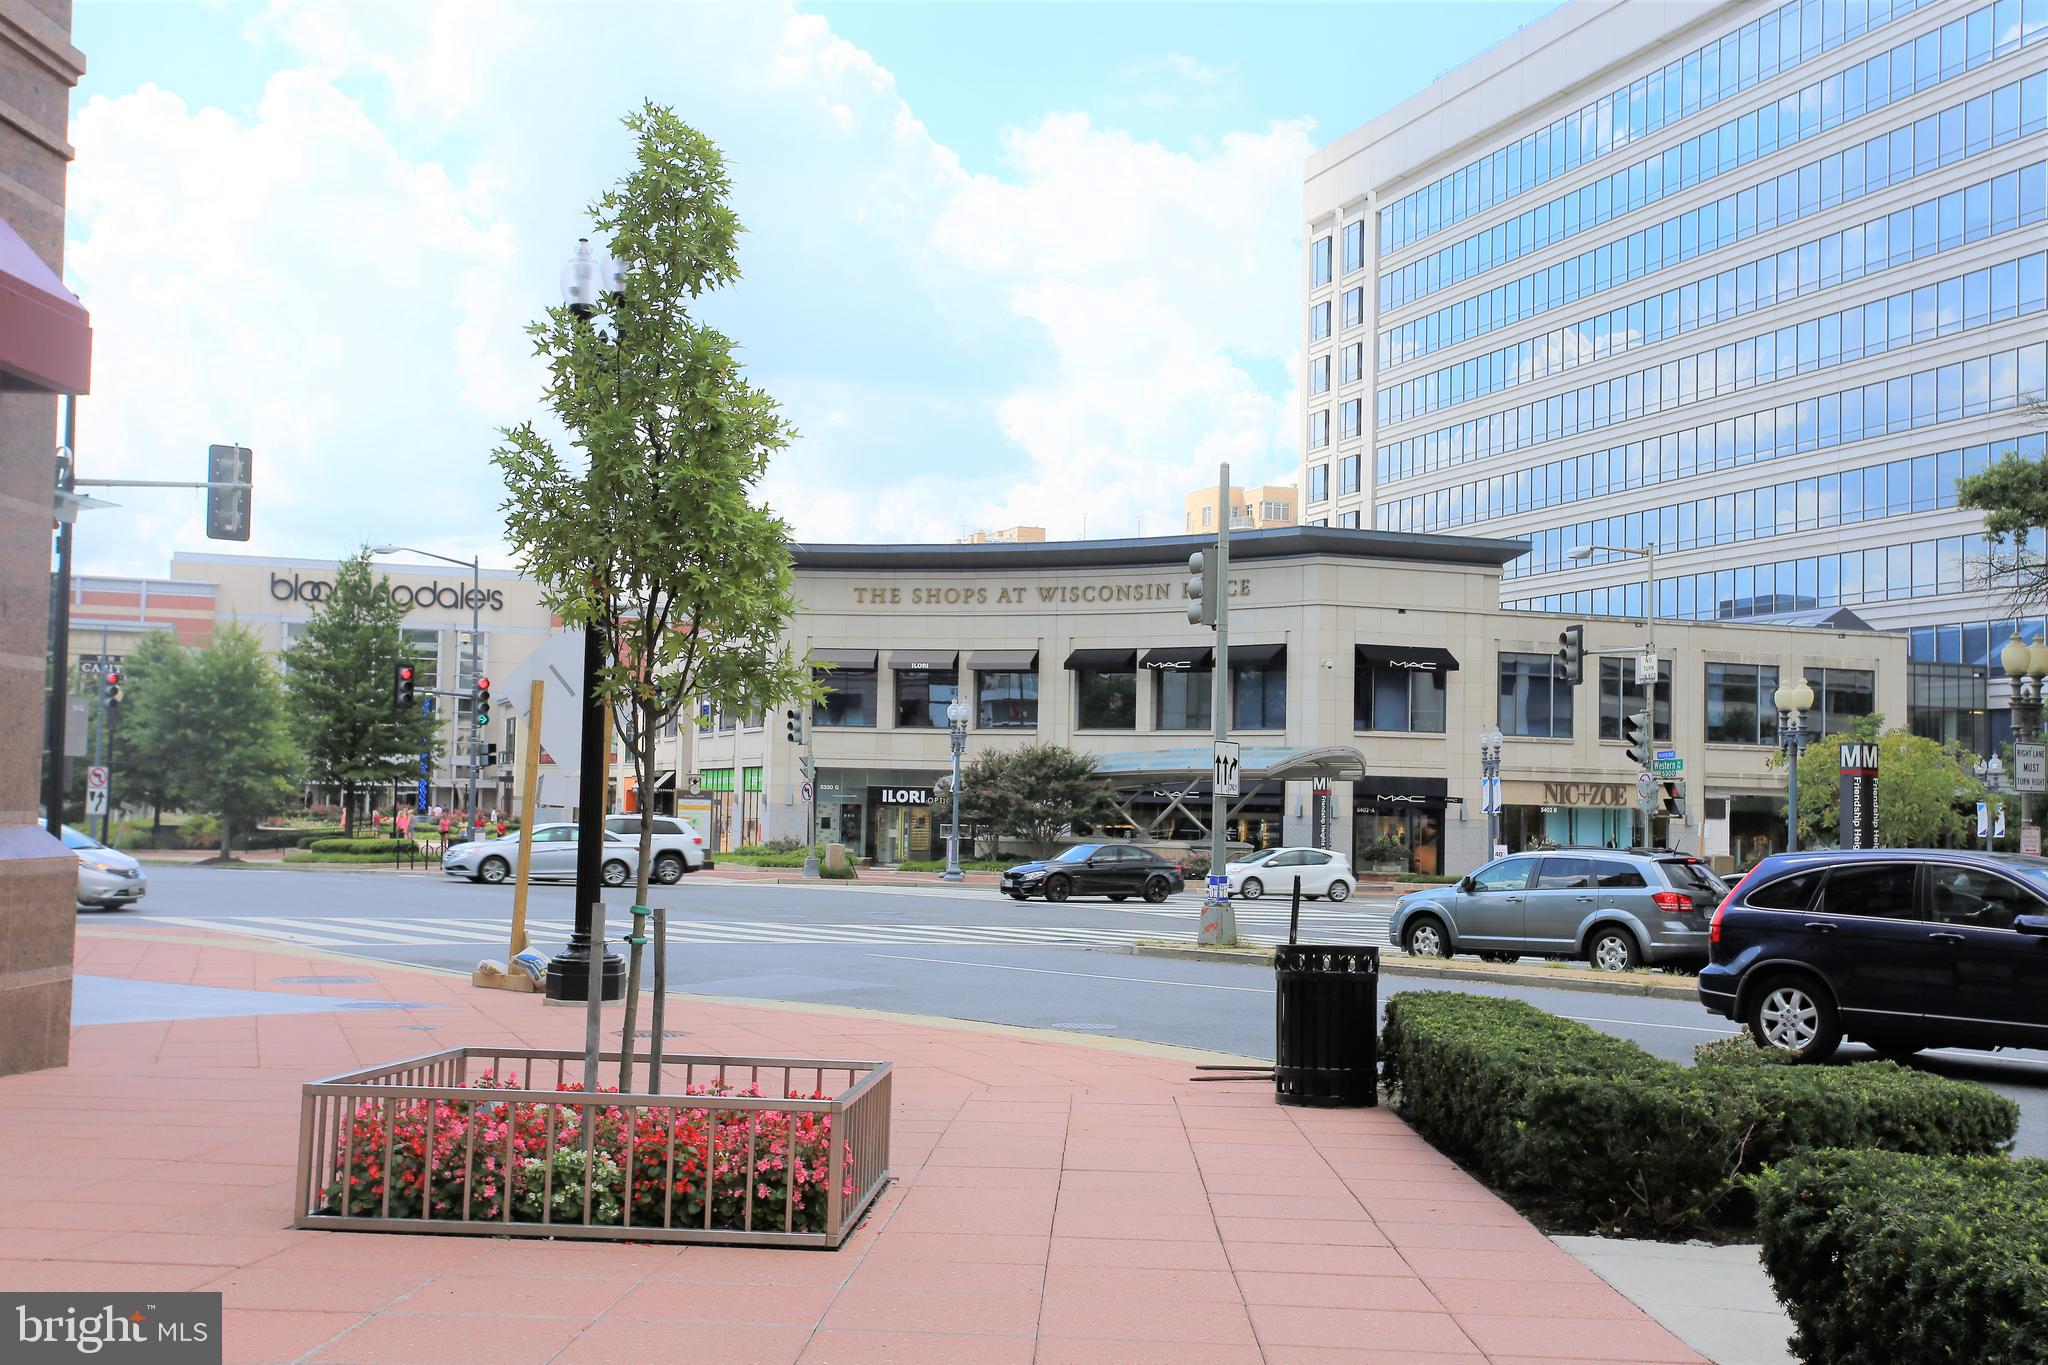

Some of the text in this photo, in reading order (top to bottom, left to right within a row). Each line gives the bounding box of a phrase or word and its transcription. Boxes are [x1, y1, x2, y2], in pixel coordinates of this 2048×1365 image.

[271, 572, 504, 613] bloogdale's
[854, 578, 1250, 604] THE SHOPS AT WISCONSIN PCE
[1841, 745, 1860, 768] M
[1862, 745, 1877, 768] M
[2017, 749, 2045, 758] RIGHT LANE
[1653, 761, 1676, 770] Western
[2023, 763, 2039, 773] MUST
[1313, 777, 1326, 790] M
[2017, 778, 2045, 786] TURN RIGHT
[882, 789, 926, 803] ILORI
[1543, 783, 1627, 806] NIC+ZOE
[1852, 777, 1862, 850] Friendship Heig
